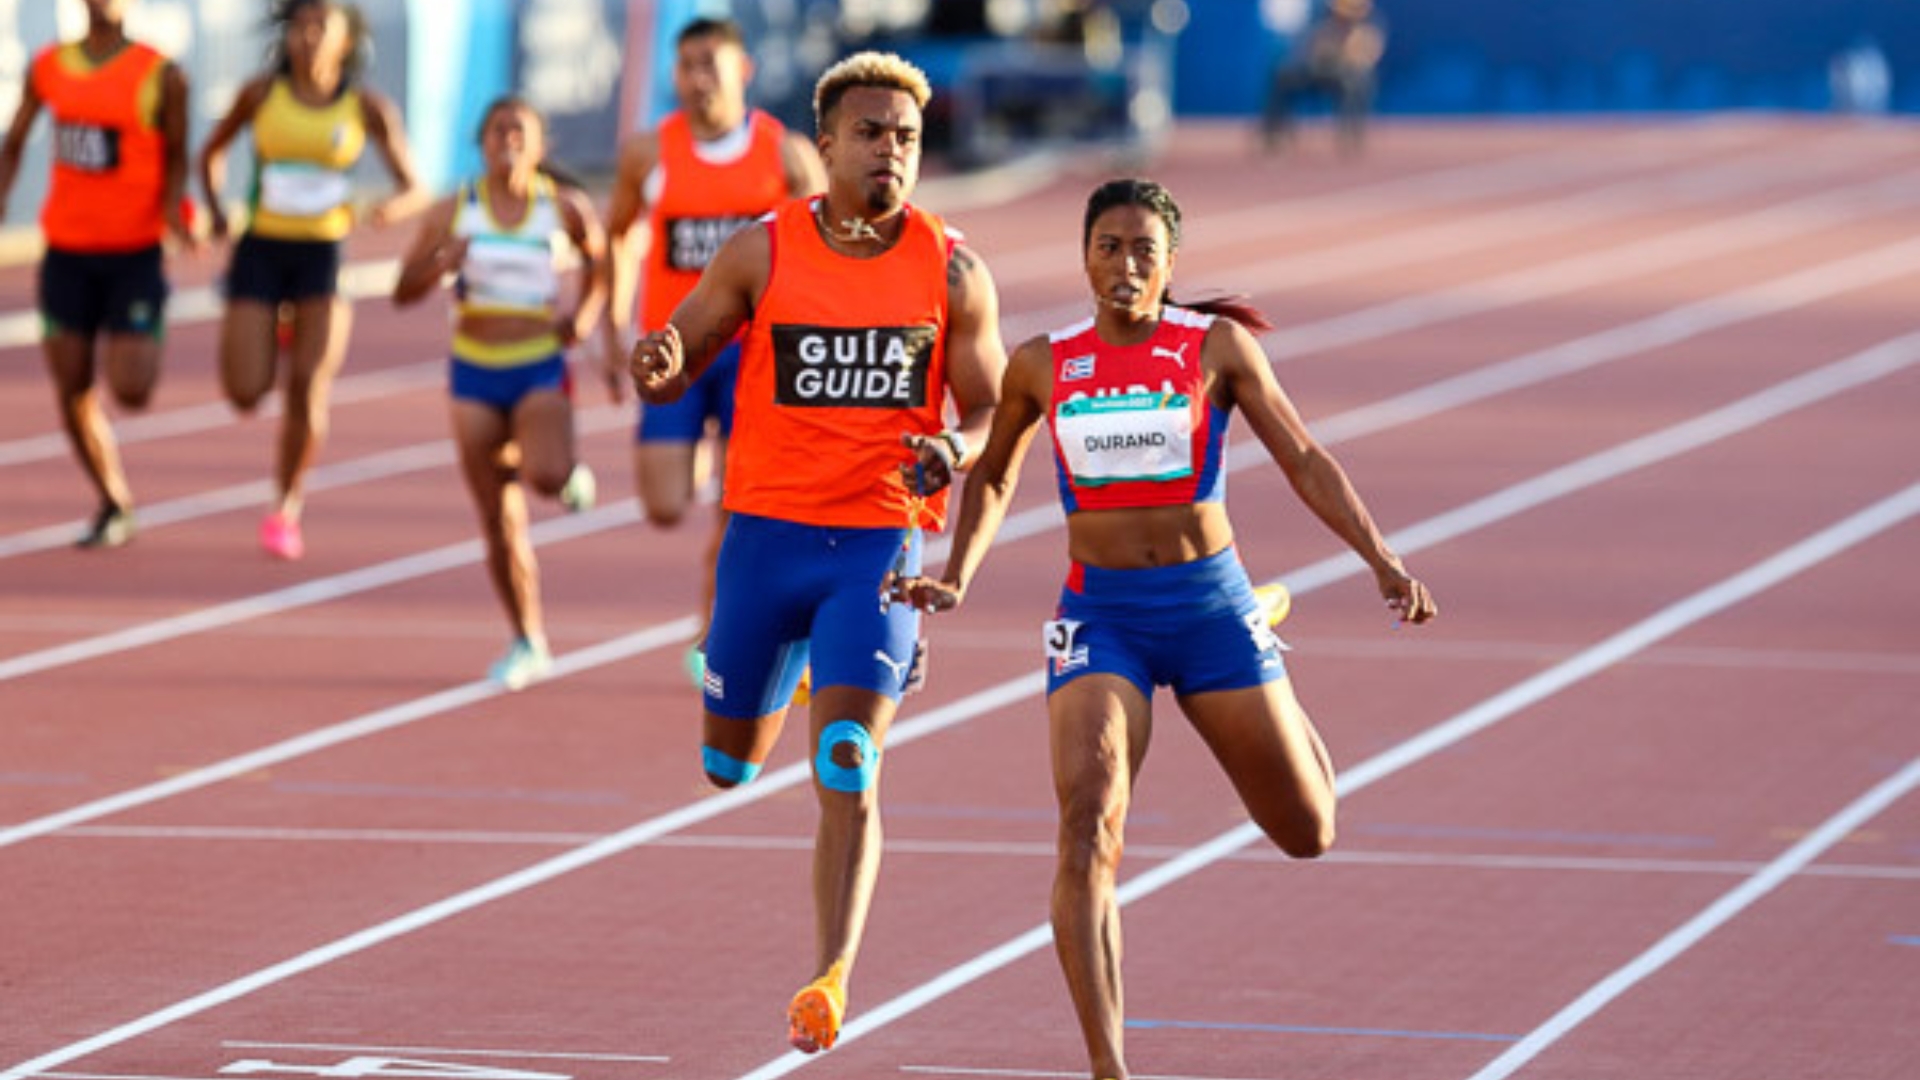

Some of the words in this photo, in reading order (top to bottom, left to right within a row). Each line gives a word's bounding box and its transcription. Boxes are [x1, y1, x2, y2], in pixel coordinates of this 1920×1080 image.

[798, 329, 907, 366] GUÍA
[795, 367, 911, 399] GUIDE
[1084, 432, 1166, 453] DURAND
